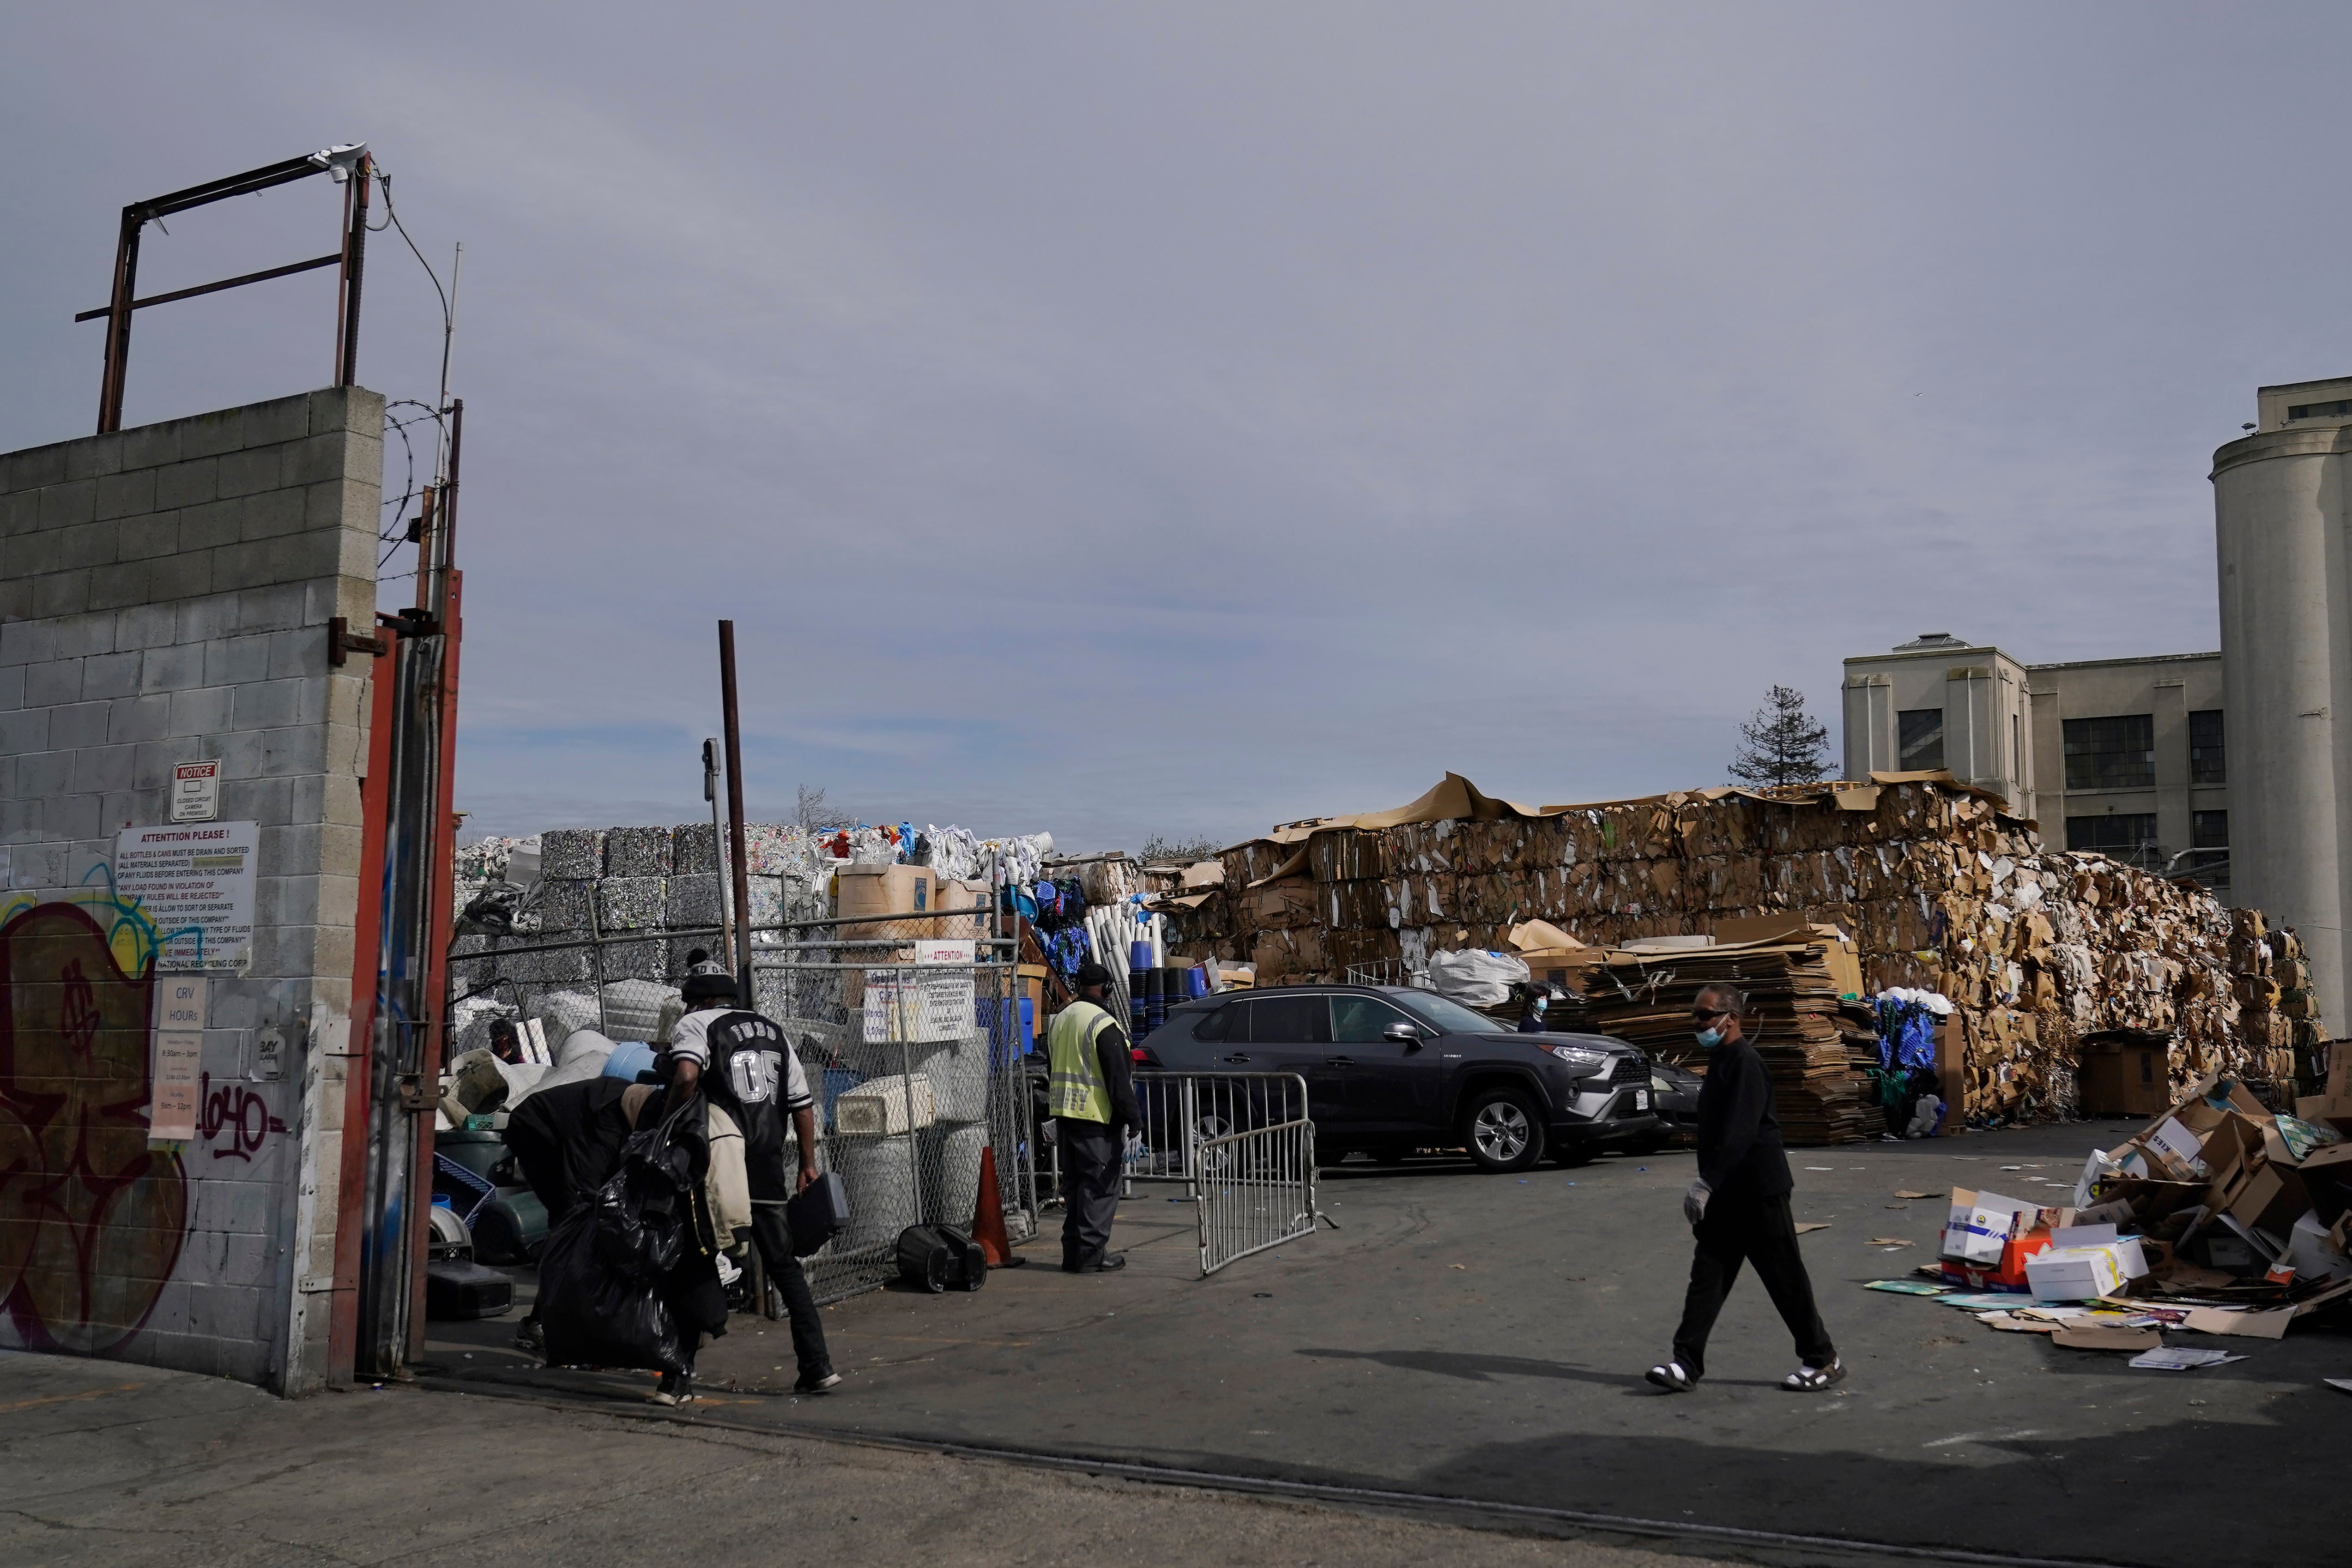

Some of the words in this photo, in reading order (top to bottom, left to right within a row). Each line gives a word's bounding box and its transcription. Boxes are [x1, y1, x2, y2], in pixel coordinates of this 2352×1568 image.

[180, 766, 212, 778] NOTICE
[141, 832, 190, 843] ATTENTTION
[193, 830, 224, 840] PLEASE
[159, 859, 190, 868] SEPARATED)
[175, 881, 205, 890] VIOLATION
[933, 950, 963, 961] ATTENTION
[176, 987, 194, 999] CRV
